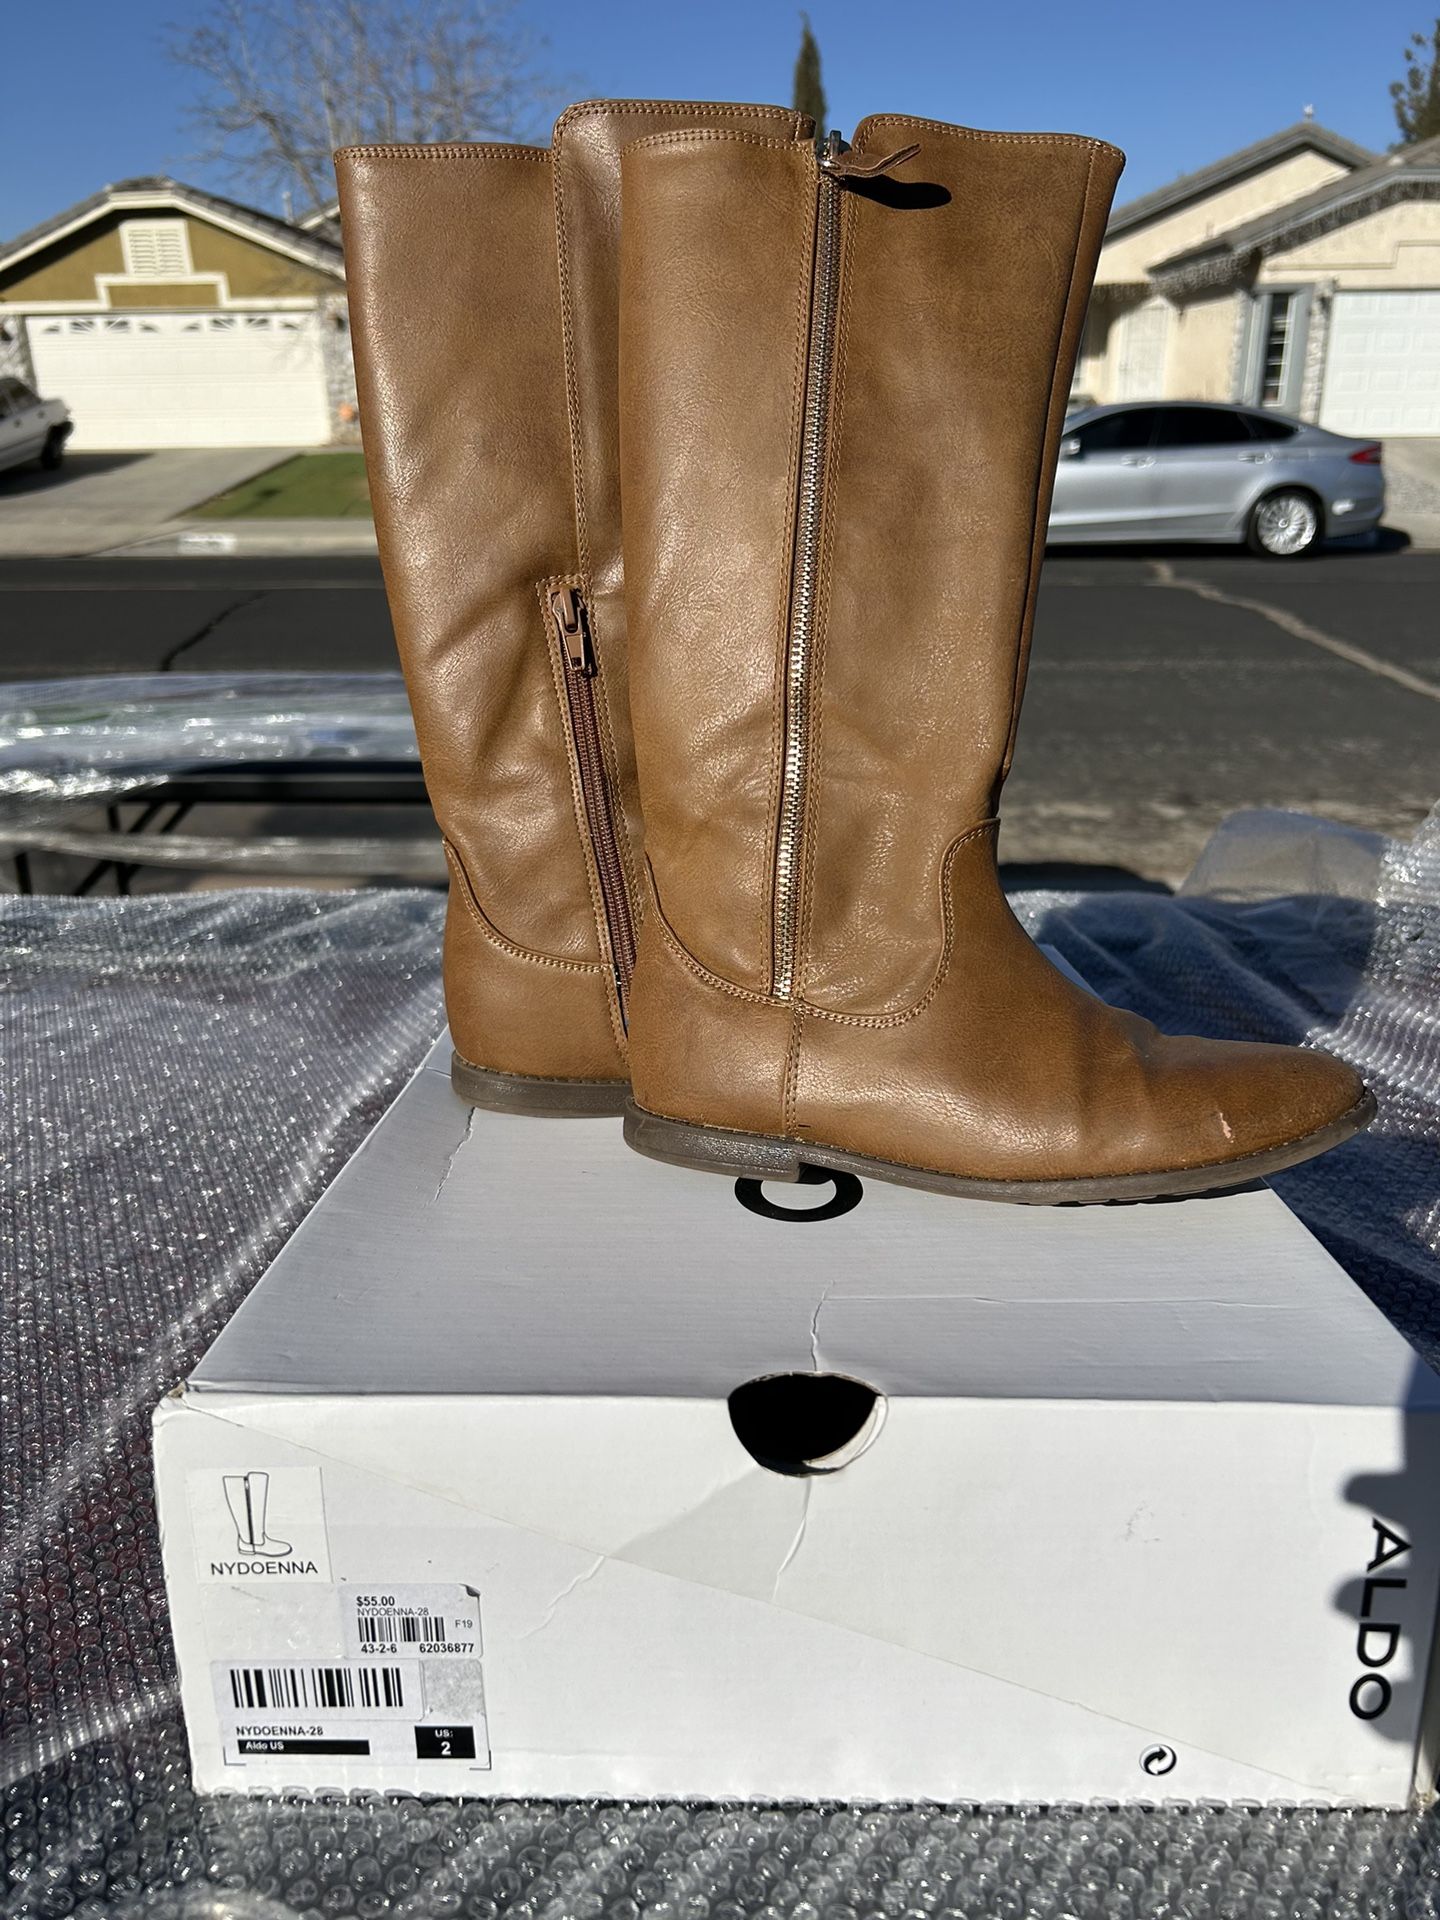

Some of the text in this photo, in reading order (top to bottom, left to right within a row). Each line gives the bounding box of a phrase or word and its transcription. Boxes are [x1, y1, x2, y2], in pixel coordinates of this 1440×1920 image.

[210, 1561, 318, 1575] NYDOENNA
[356, 1595, 395, 1607] $55.00
[357, 1607, 429, 1616] NYDOENNA-28
[1349, 1517, 1413, 1720] ALDO
[361, 1643, 474, 1653] 43-2-6 62036877
[236, 1726, 323, 1736] NYDOENNA-28
[245, 1741, 284, 1751] Aldo US
[441, 1742, 452, 1755] 2
